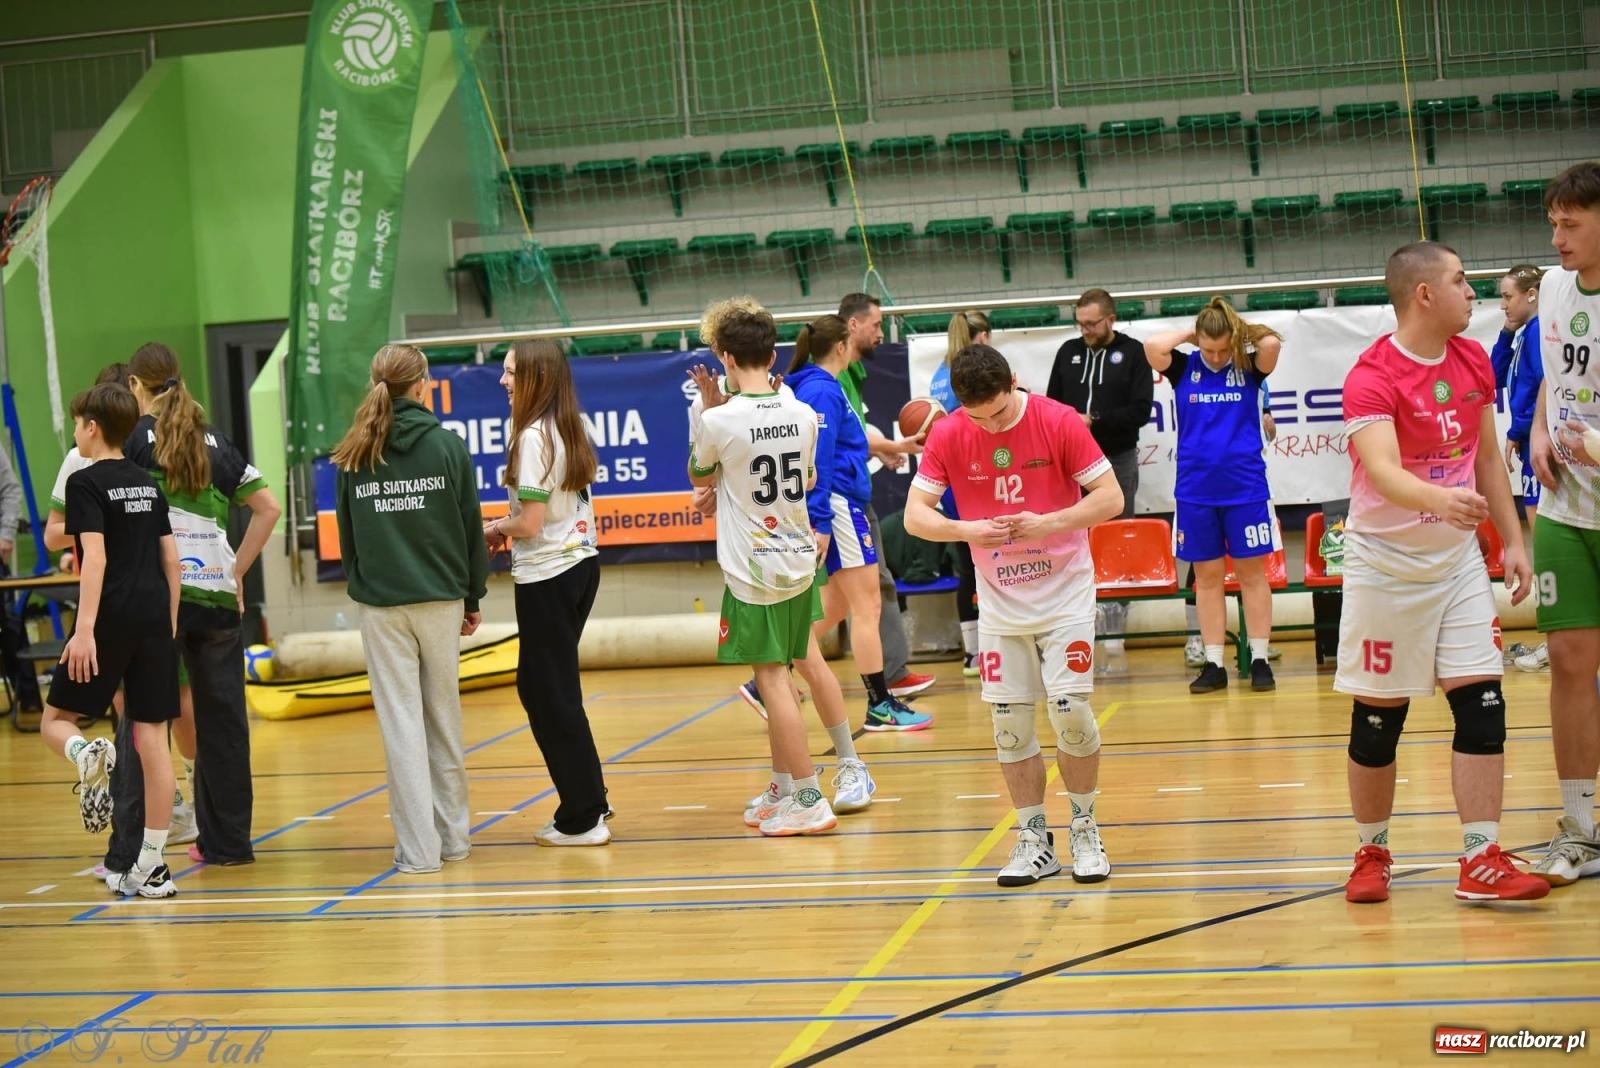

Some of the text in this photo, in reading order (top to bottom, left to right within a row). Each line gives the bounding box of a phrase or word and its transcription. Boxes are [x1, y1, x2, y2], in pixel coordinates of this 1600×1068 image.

[329, 2, 358, 35] KLUB
[334, 58, 398, 87] RACIBÓRZ
[306, 108, 338, 375] KLUB SIATKARSKI
[327, 169, 364, 322] RACIBÓRZ
[1561, 343, 1590, 376] 99
[1198, 392, 1242, 403] BETARD
[750, 424, 800, 444] JAROCKI
[1436, 409, 1462, 442] 15
[614, 457, 648, 482] 55
[750, 451, 805, 506] 35
[355, 476, 446, 499] KLUB SIATKARSKI
[994, 474, 1025, 504] 42
[1523, 474, 1538, 497] 21
[374, 495, 426, 513] RACIBÓRZ
[1244, 522, 1270, 548] 96
[997, 559, 1052, 578] PIVEXIN
[1000, 570, 1051, 586] TECHNOLOGY
[1362, 639, 1393, 675] 15
